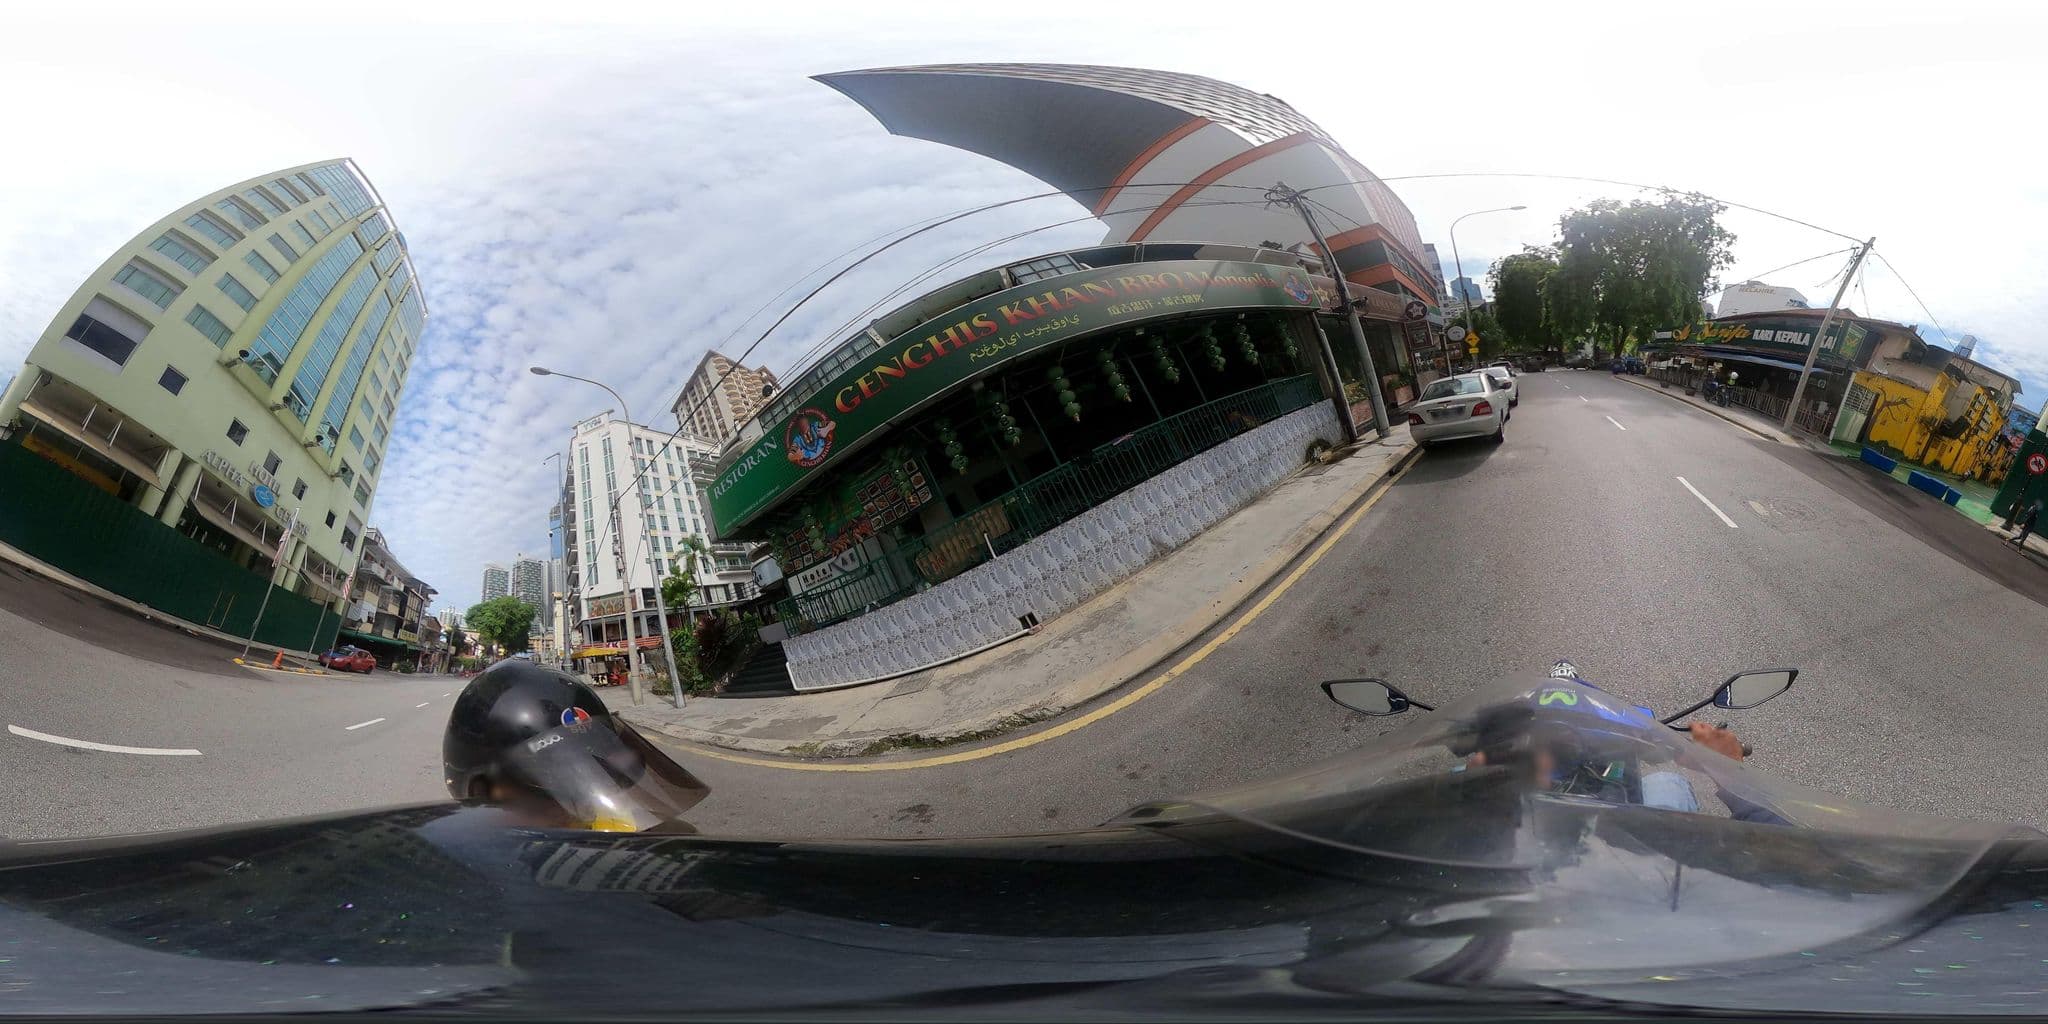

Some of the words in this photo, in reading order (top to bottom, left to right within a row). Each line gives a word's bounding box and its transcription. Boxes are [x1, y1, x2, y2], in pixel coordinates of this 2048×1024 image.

[835, 312, 999, 414] GENGHIS
[997, 279, 1117, 326] KHAN
[1118, 271, 1183, 292] BBQ
[1775, 330, 1811, 346] KEPALA
[200, 449, 246, 488] ALPHA
[248, 460, 282, 498] HOTEL
[713, 435, 779, 500] RESTORAN
[802, 563, 833, 584] Hotel
